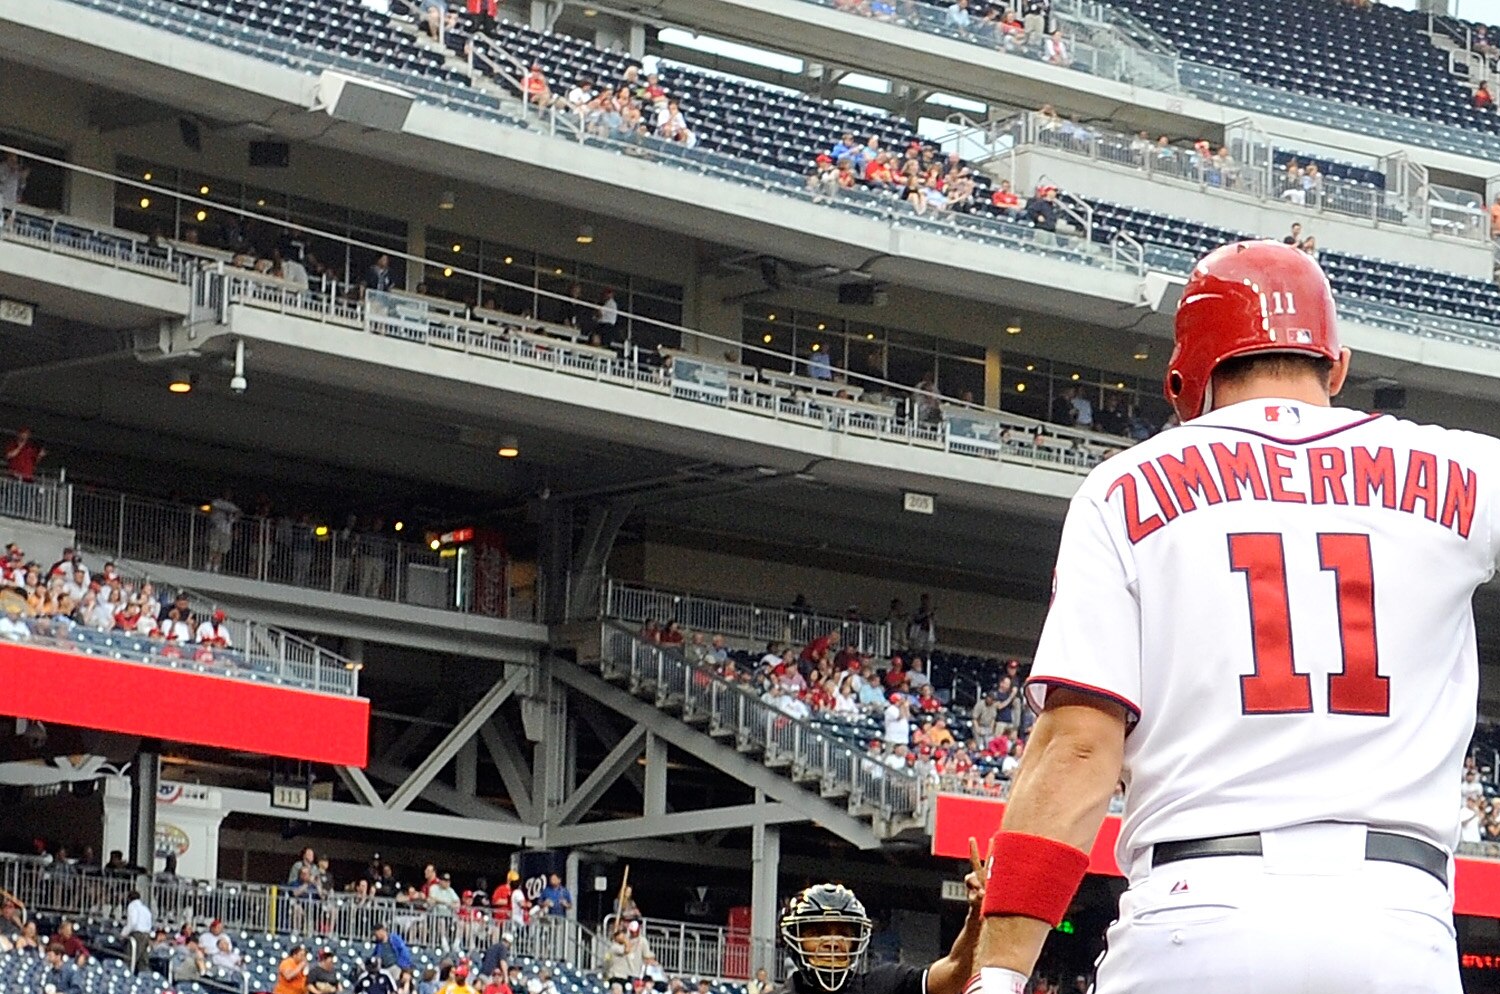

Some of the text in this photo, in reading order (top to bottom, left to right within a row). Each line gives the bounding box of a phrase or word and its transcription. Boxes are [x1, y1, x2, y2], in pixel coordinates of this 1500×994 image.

[1271, 291, 1296, 314] 11
[1105, 441, 1477, 545] ZIMMERMAN
[1226, 532, 1390, 717] 11
[280, 790, 301, 804] 113
